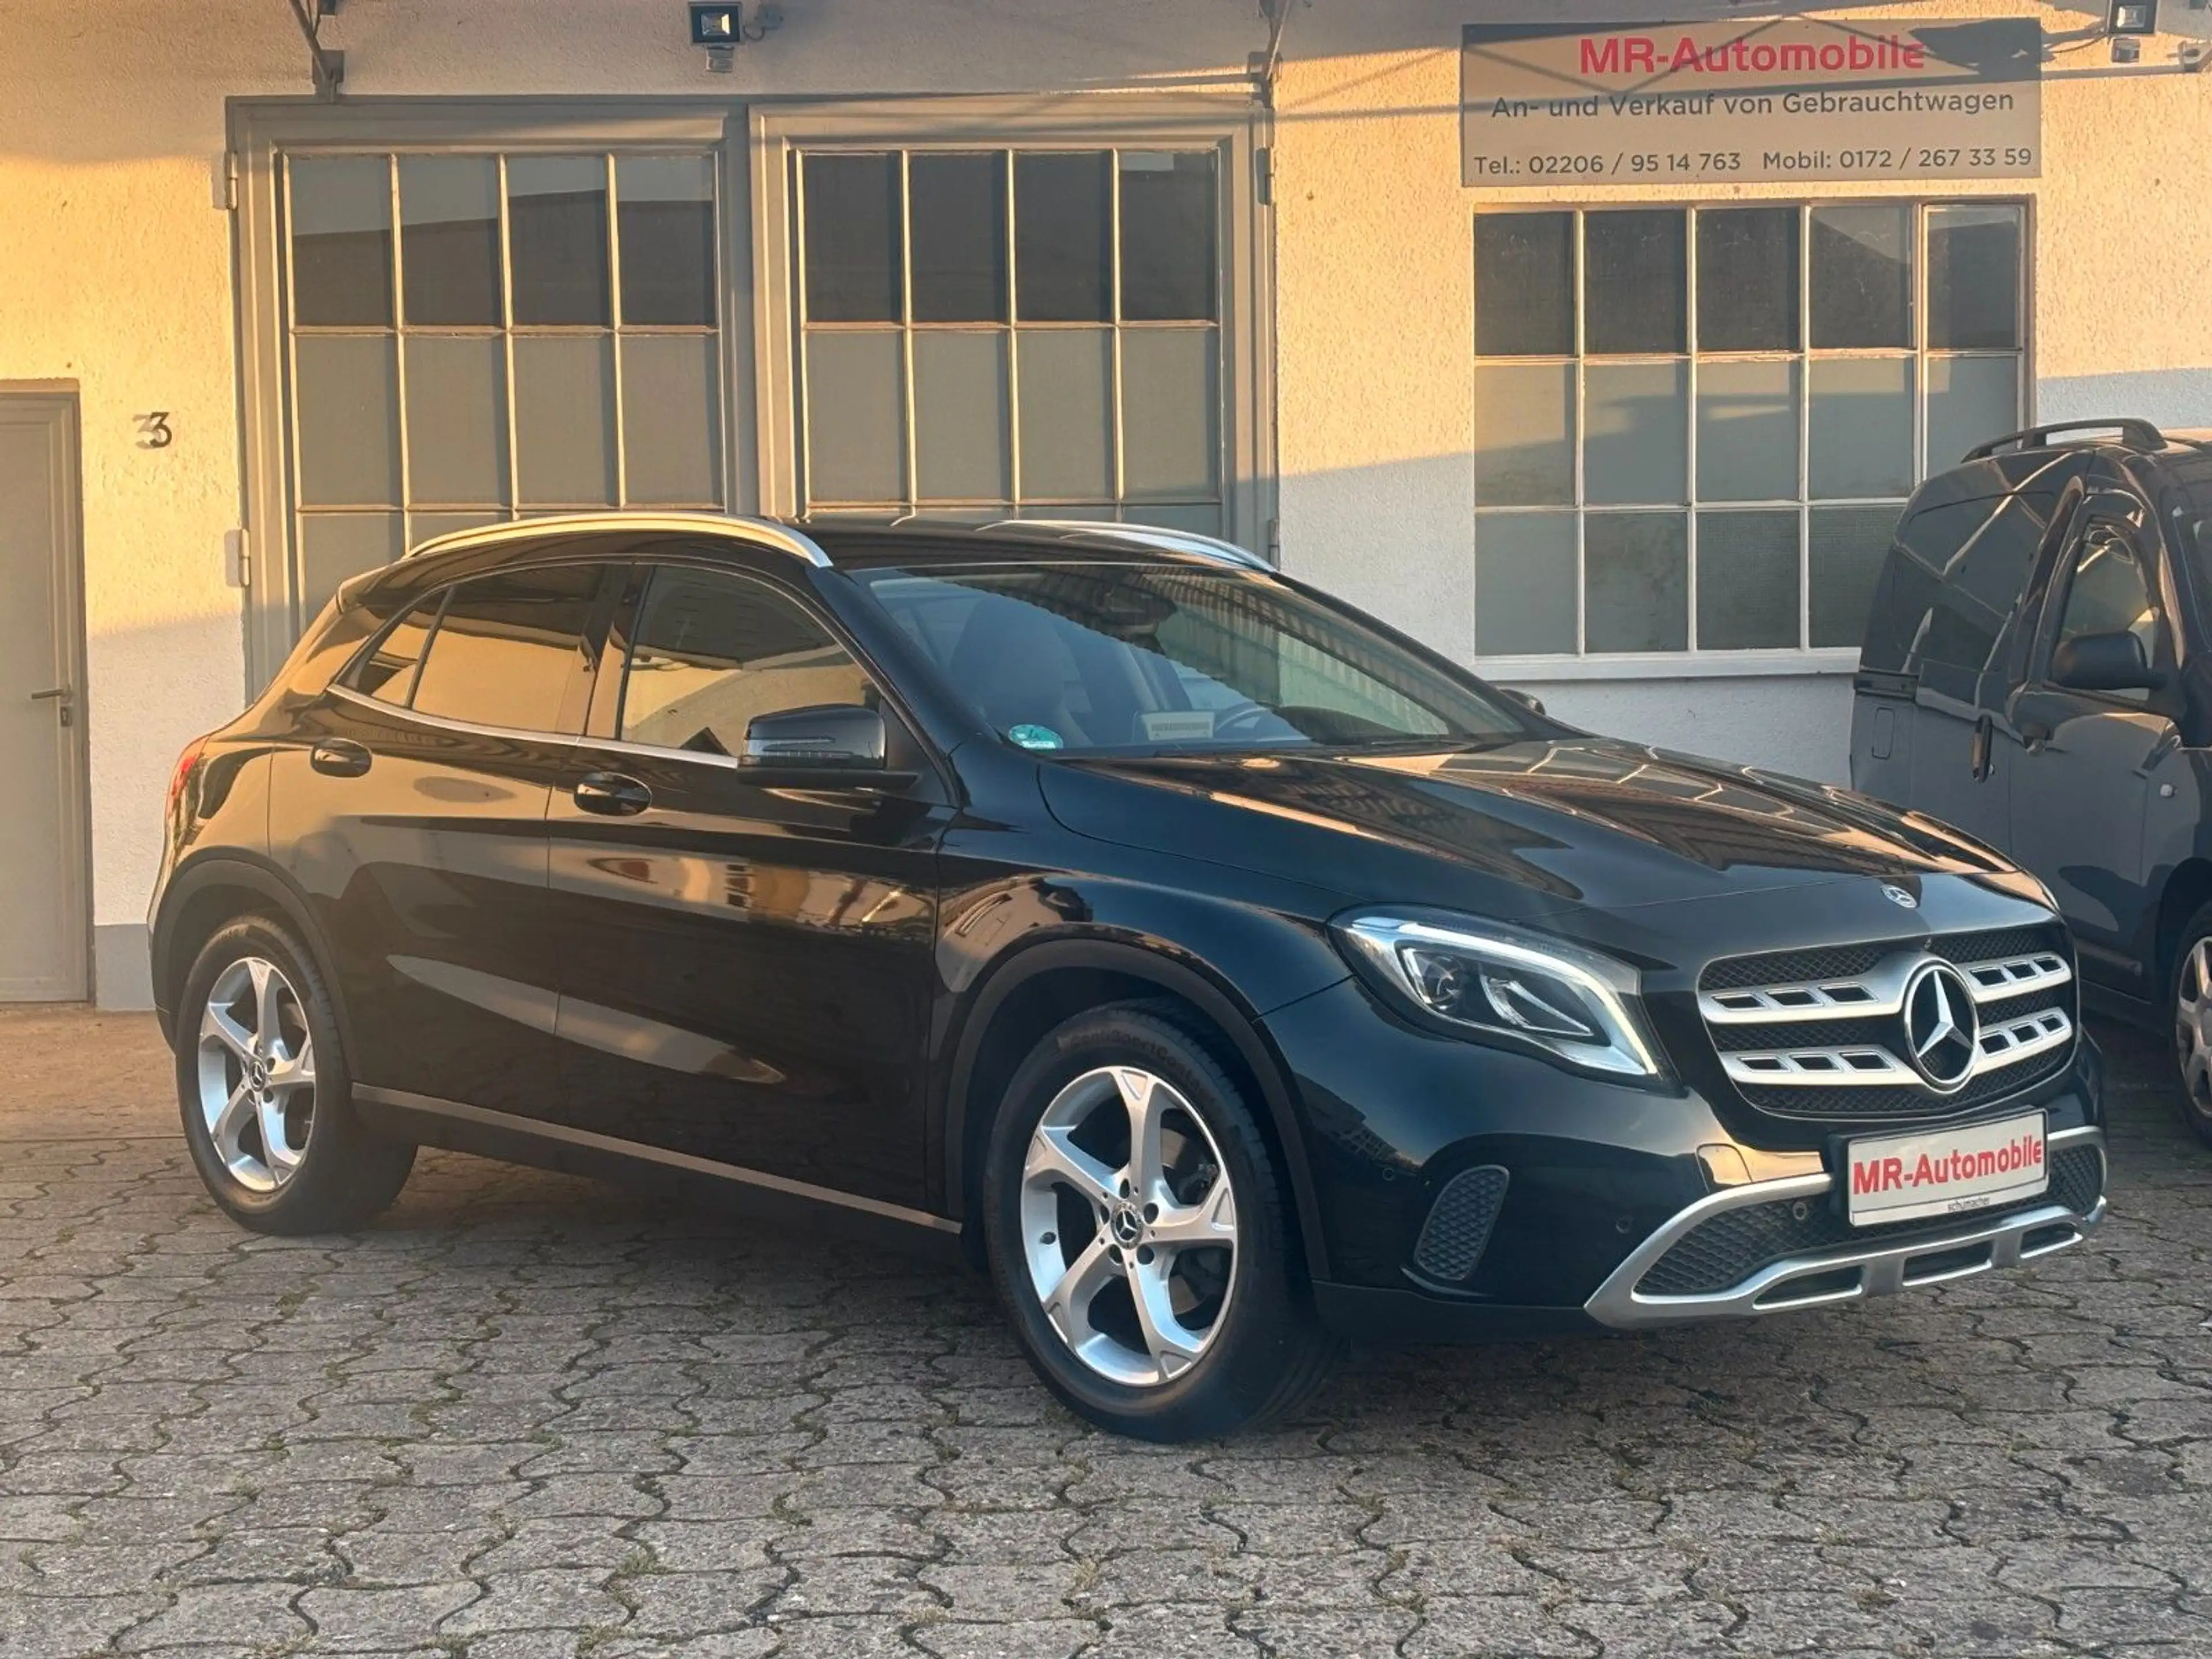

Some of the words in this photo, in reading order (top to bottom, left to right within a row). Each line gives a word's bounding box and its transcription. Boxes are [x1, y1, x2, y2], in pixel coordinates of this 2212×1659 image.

[1580, 34, 1925, 74] MR-Automobile
[1491, 96, 1539, 118] An-
[1549, 94, 1599, 117] und
[1609, 93, 1715, 116] Verkauf
[1724, 97, 1772, 115] von
[1782, 90, 2014, 115] Gebrauchtwagen
[1474, 156, 1520, 175] Tel.:
[1529, 155, 1604, 175] 02206
[1611, 152, 1624, 175] /
[1631, 154, 1659, 172] 95
[1667, 154, 1691, 172] 14
[1699, 152, 1741, 171] 763
[1763, 150, 1832, 170] Mobil:
[1840, 149, 1892, 168] 0172
[1899, 147, 1912, 170] /
[1918, 149, 1961, 168] 267
[1969, 148, 1996, 166] 33
[2005, 147, 2032, 166] 59
[150, 411, 172, 448] 3
[1853, 1135, 2042, 1195] MR-Automobile
